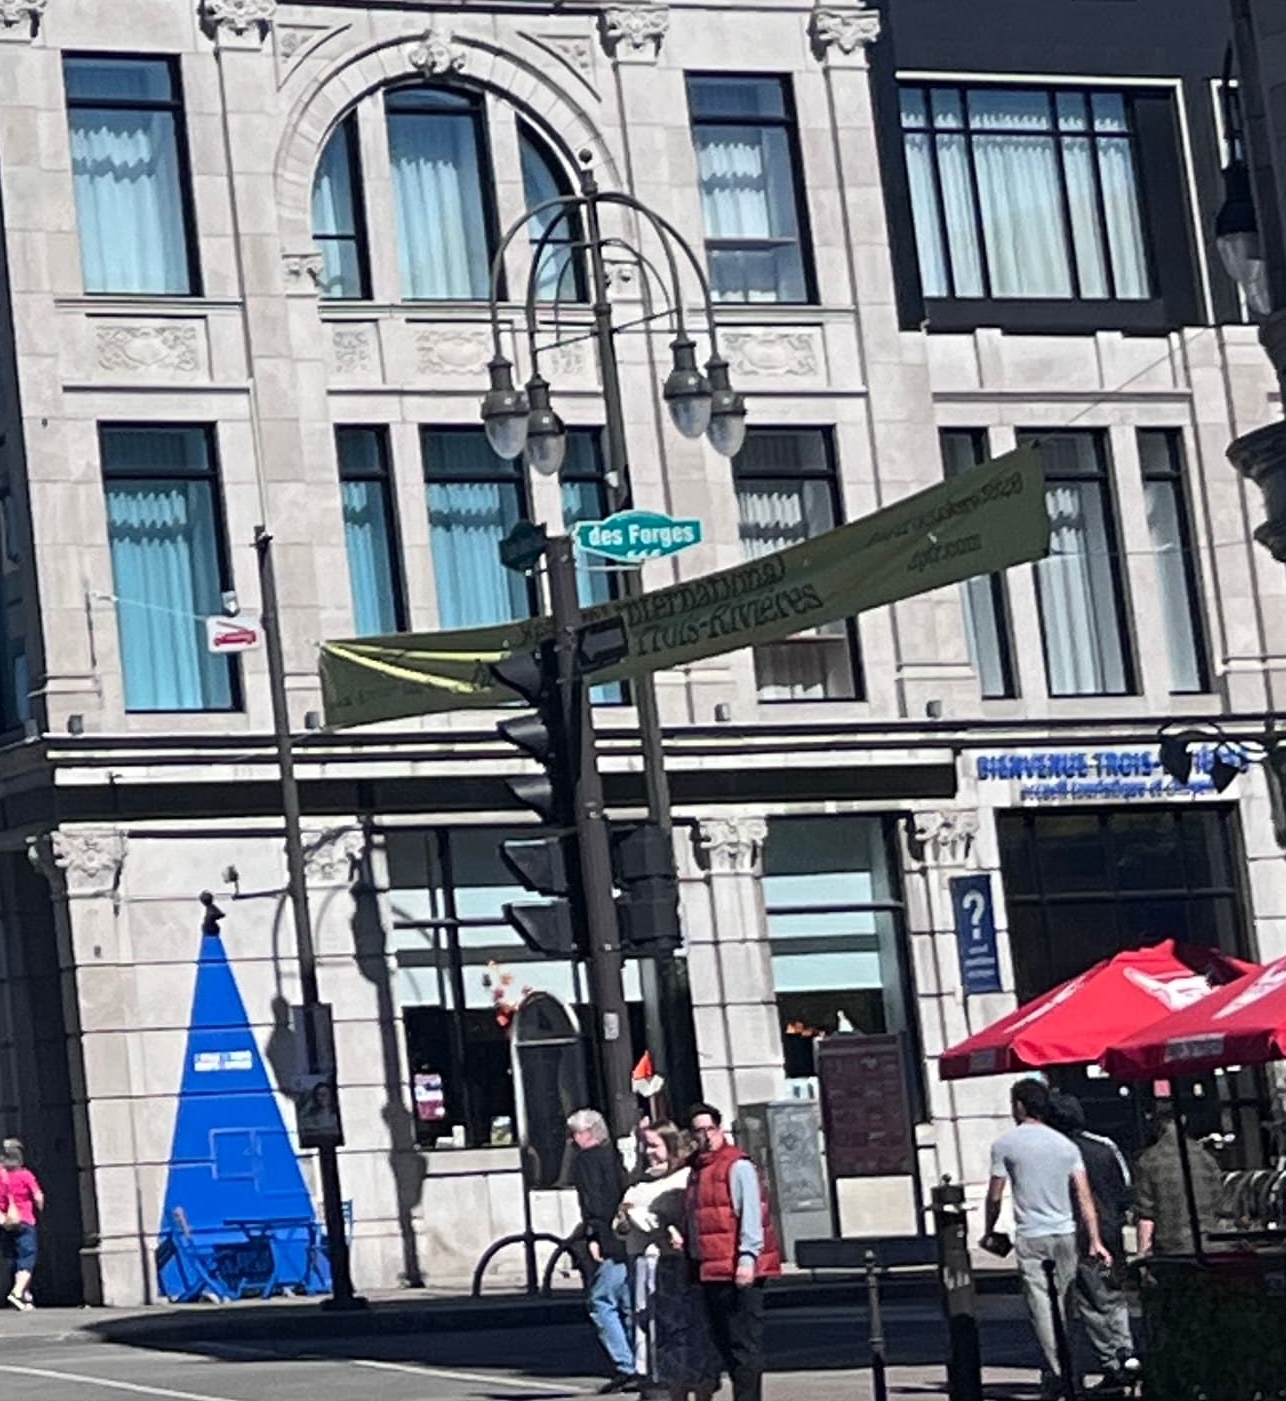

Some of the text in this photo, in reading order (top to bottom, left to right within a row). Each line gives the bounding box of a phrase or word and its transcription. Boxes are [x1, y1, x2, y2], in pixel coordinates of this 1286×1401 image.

[588, 524, 695, 549] des Forges
[977, 753, 1089, 781] BIENVENUE
